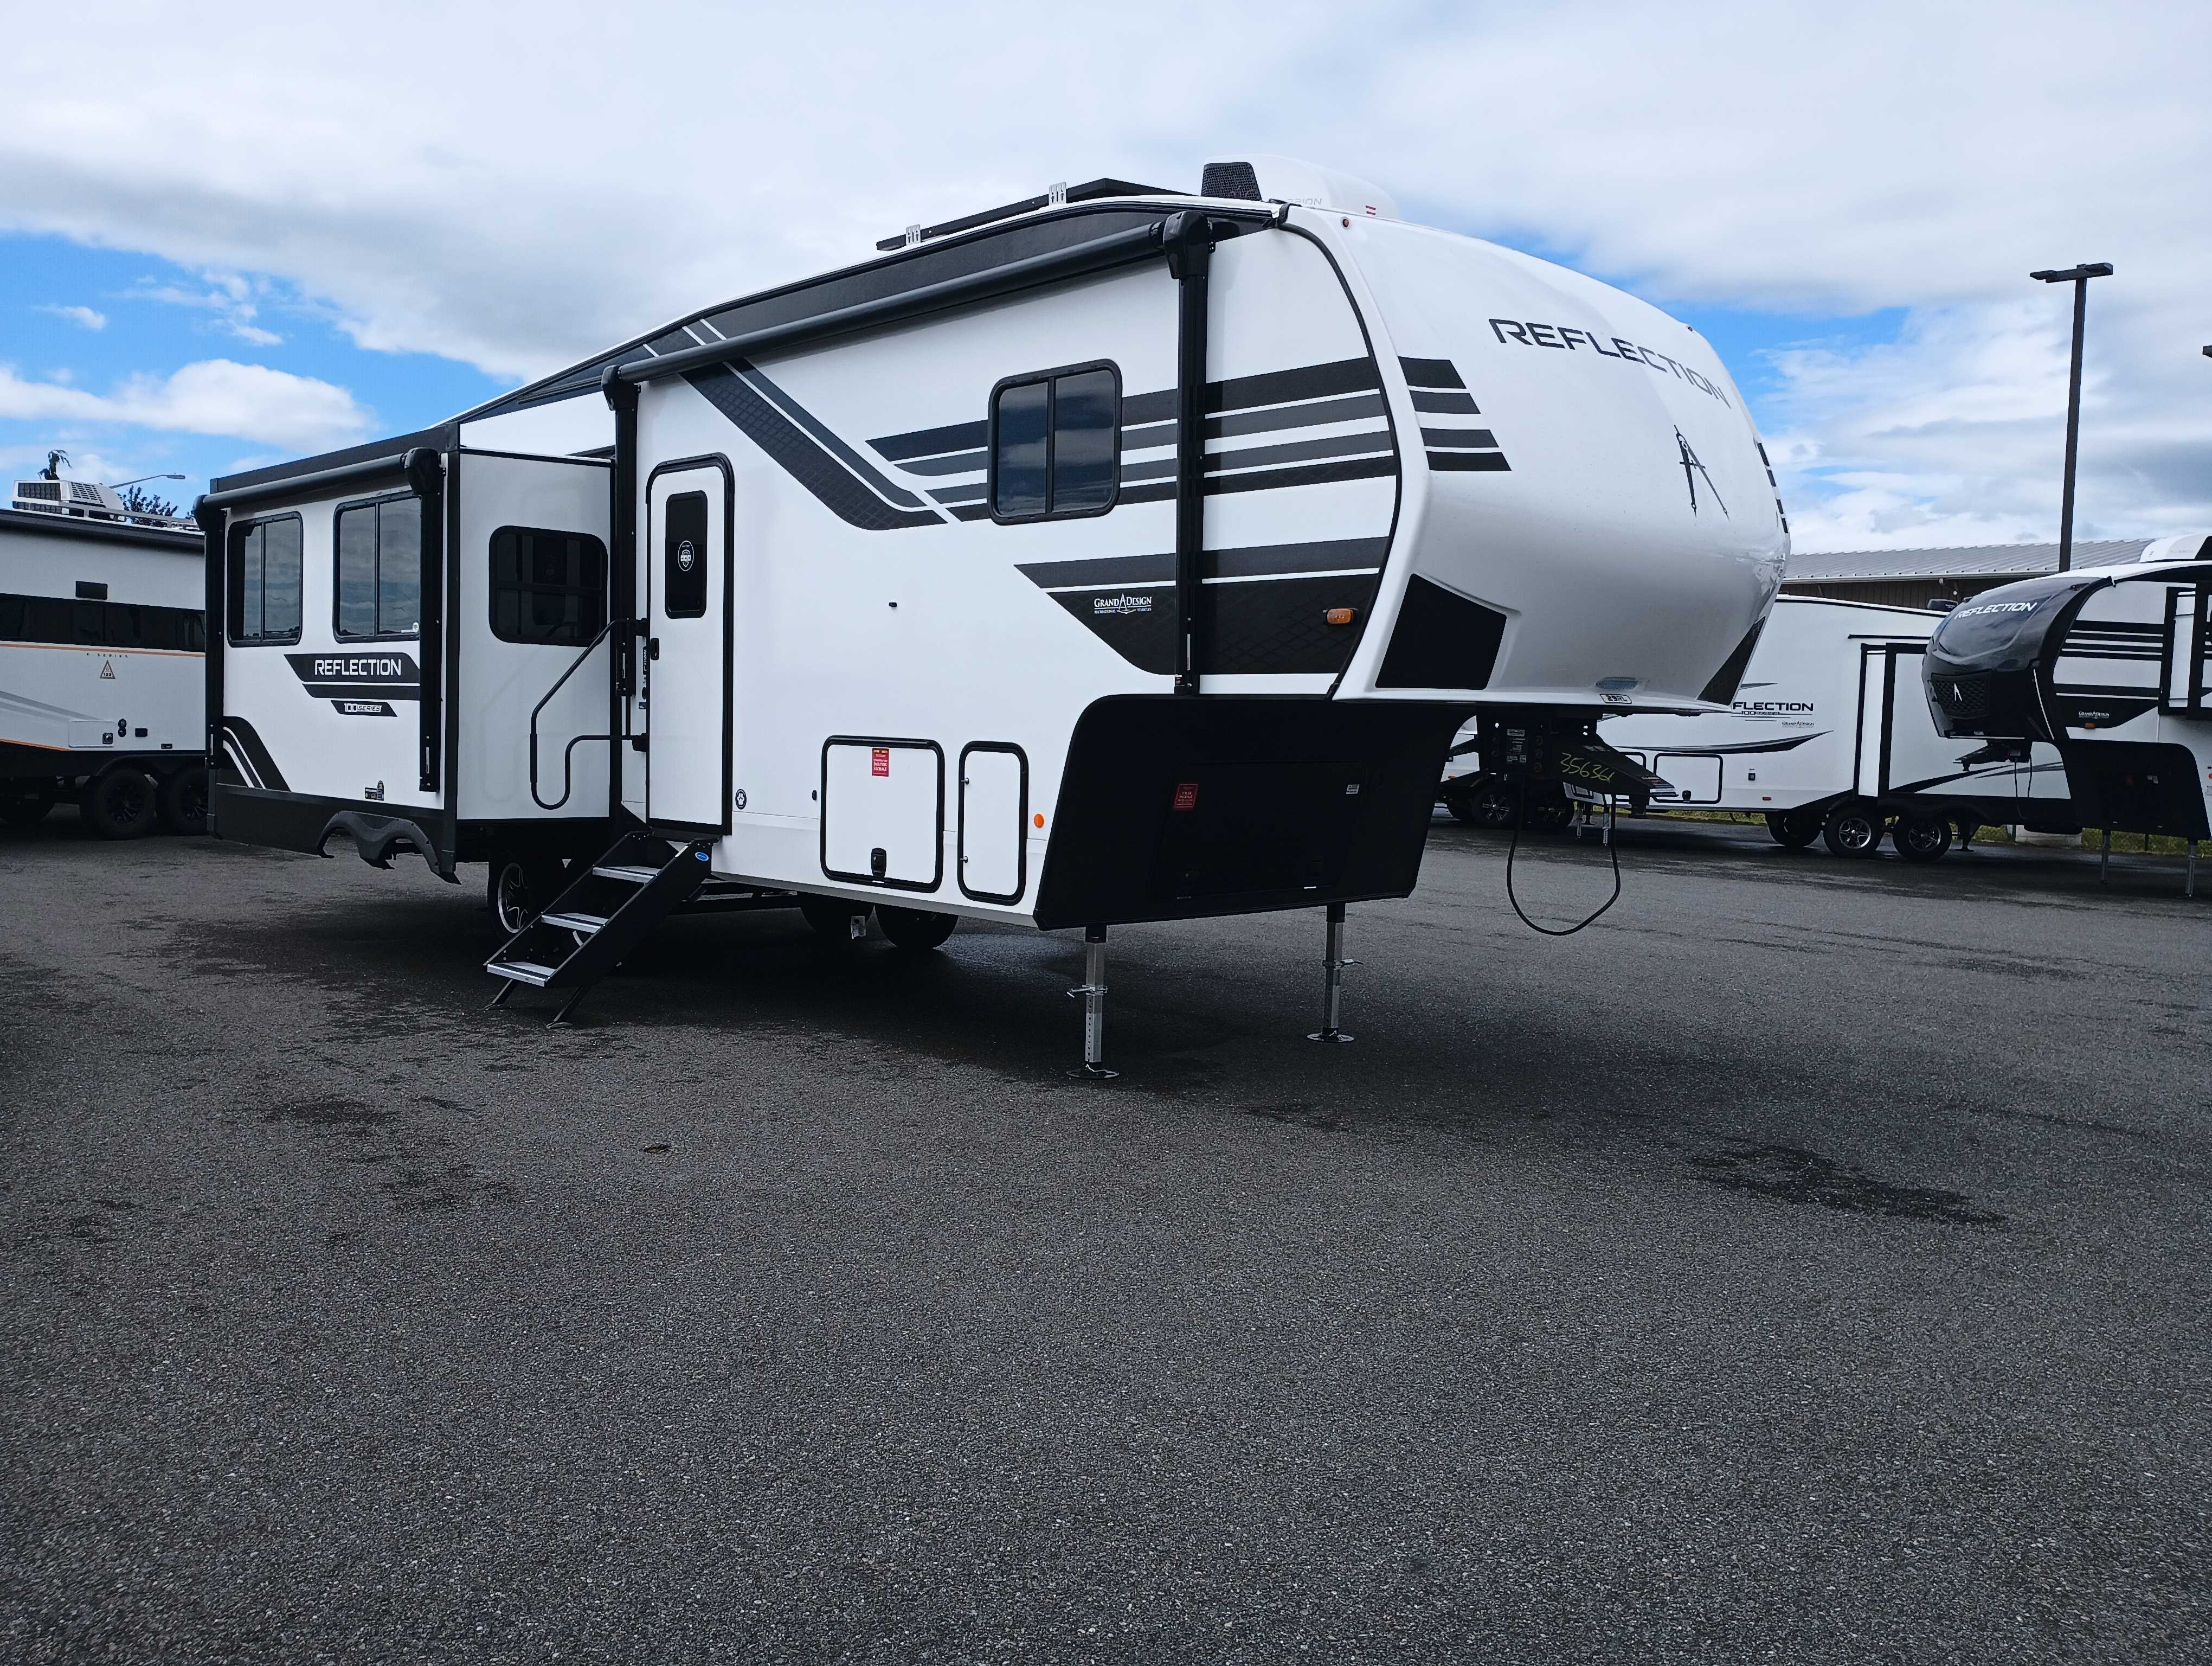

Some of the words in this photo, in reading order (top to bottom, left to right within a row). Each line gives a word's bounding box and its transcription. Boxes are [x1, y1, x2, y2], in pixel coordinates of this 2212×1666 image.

[1489, 318, 1731, 408] REFLECTION
[1094, 598, 1120, 607] GRAND
[1126, 597, 1152, 606] DESIGN
[1954, 602, 2037, 619] REFLECTION
[314, 659, 401, 676] REFLECTION
[1733, 702, 1814, 711] FLECTION
